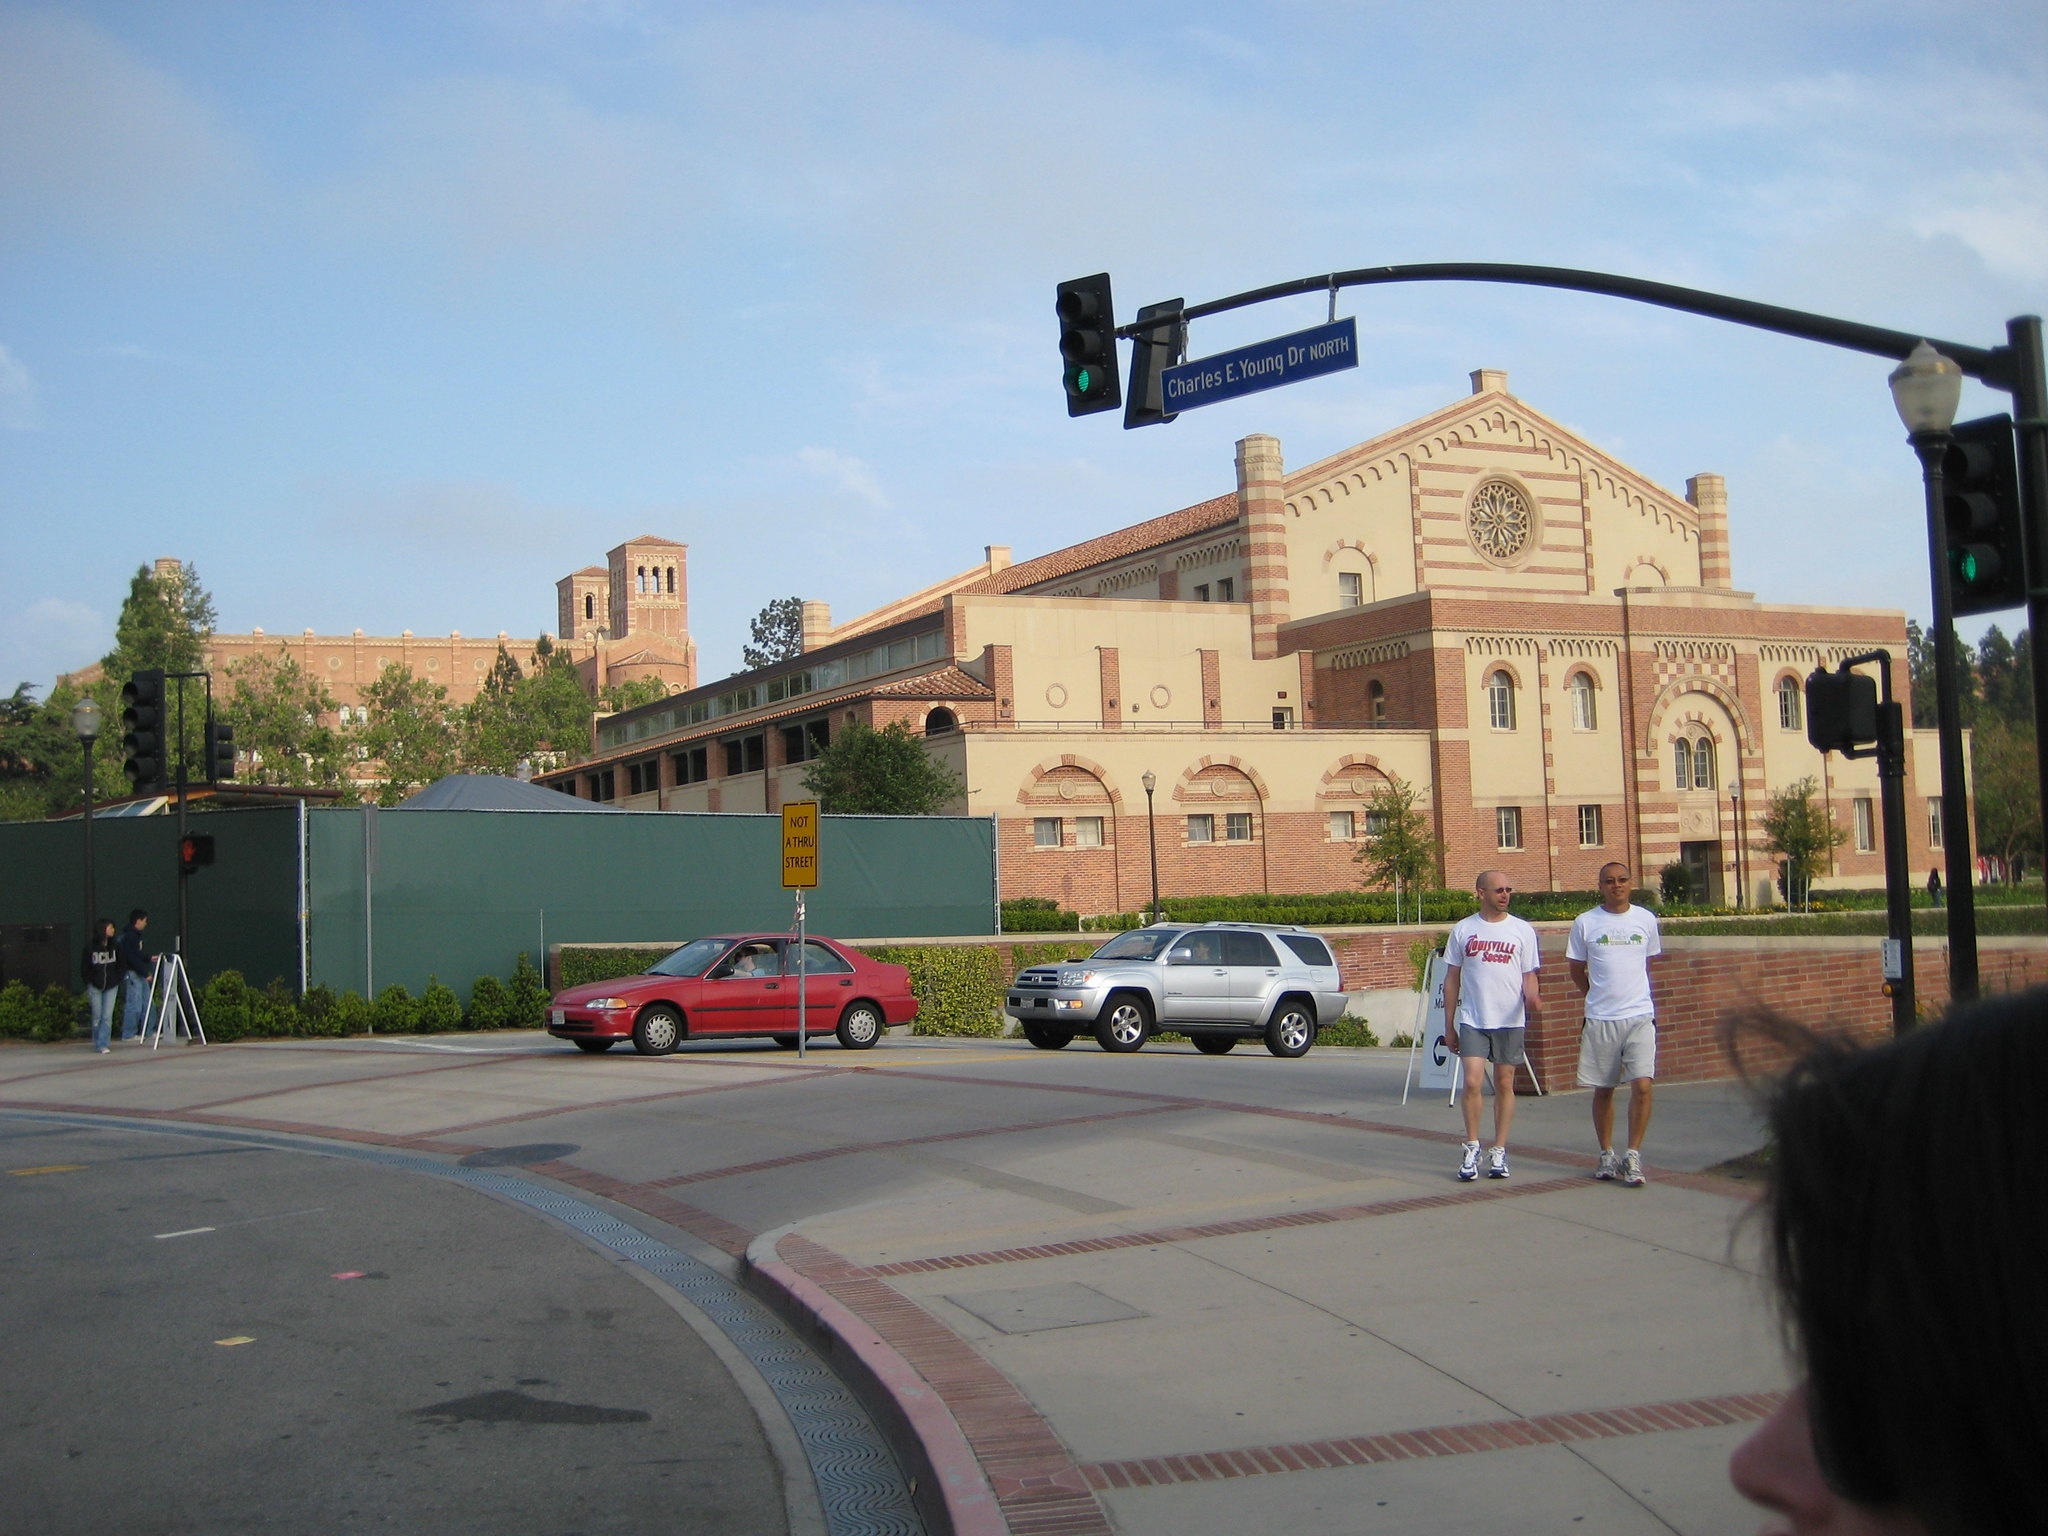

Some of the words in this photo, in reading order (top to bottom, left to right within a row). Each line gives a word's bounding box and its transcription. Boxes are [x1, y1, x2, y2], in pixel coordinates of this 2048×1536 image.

[1168, 369, 1222, 398] Charles
[1226, 363, 1239, 383] E.
[1239, 354, 1284, 379] Young
[1288, 346, 1305, 367] Dr
[1310, 336, 1349, 361] NORTH
[790, 816, 808, 828] NOT
[786, 837, 791, 848] A
[792, 836, 814, 848] THRU
[785, 856, 814, 868] STREET
